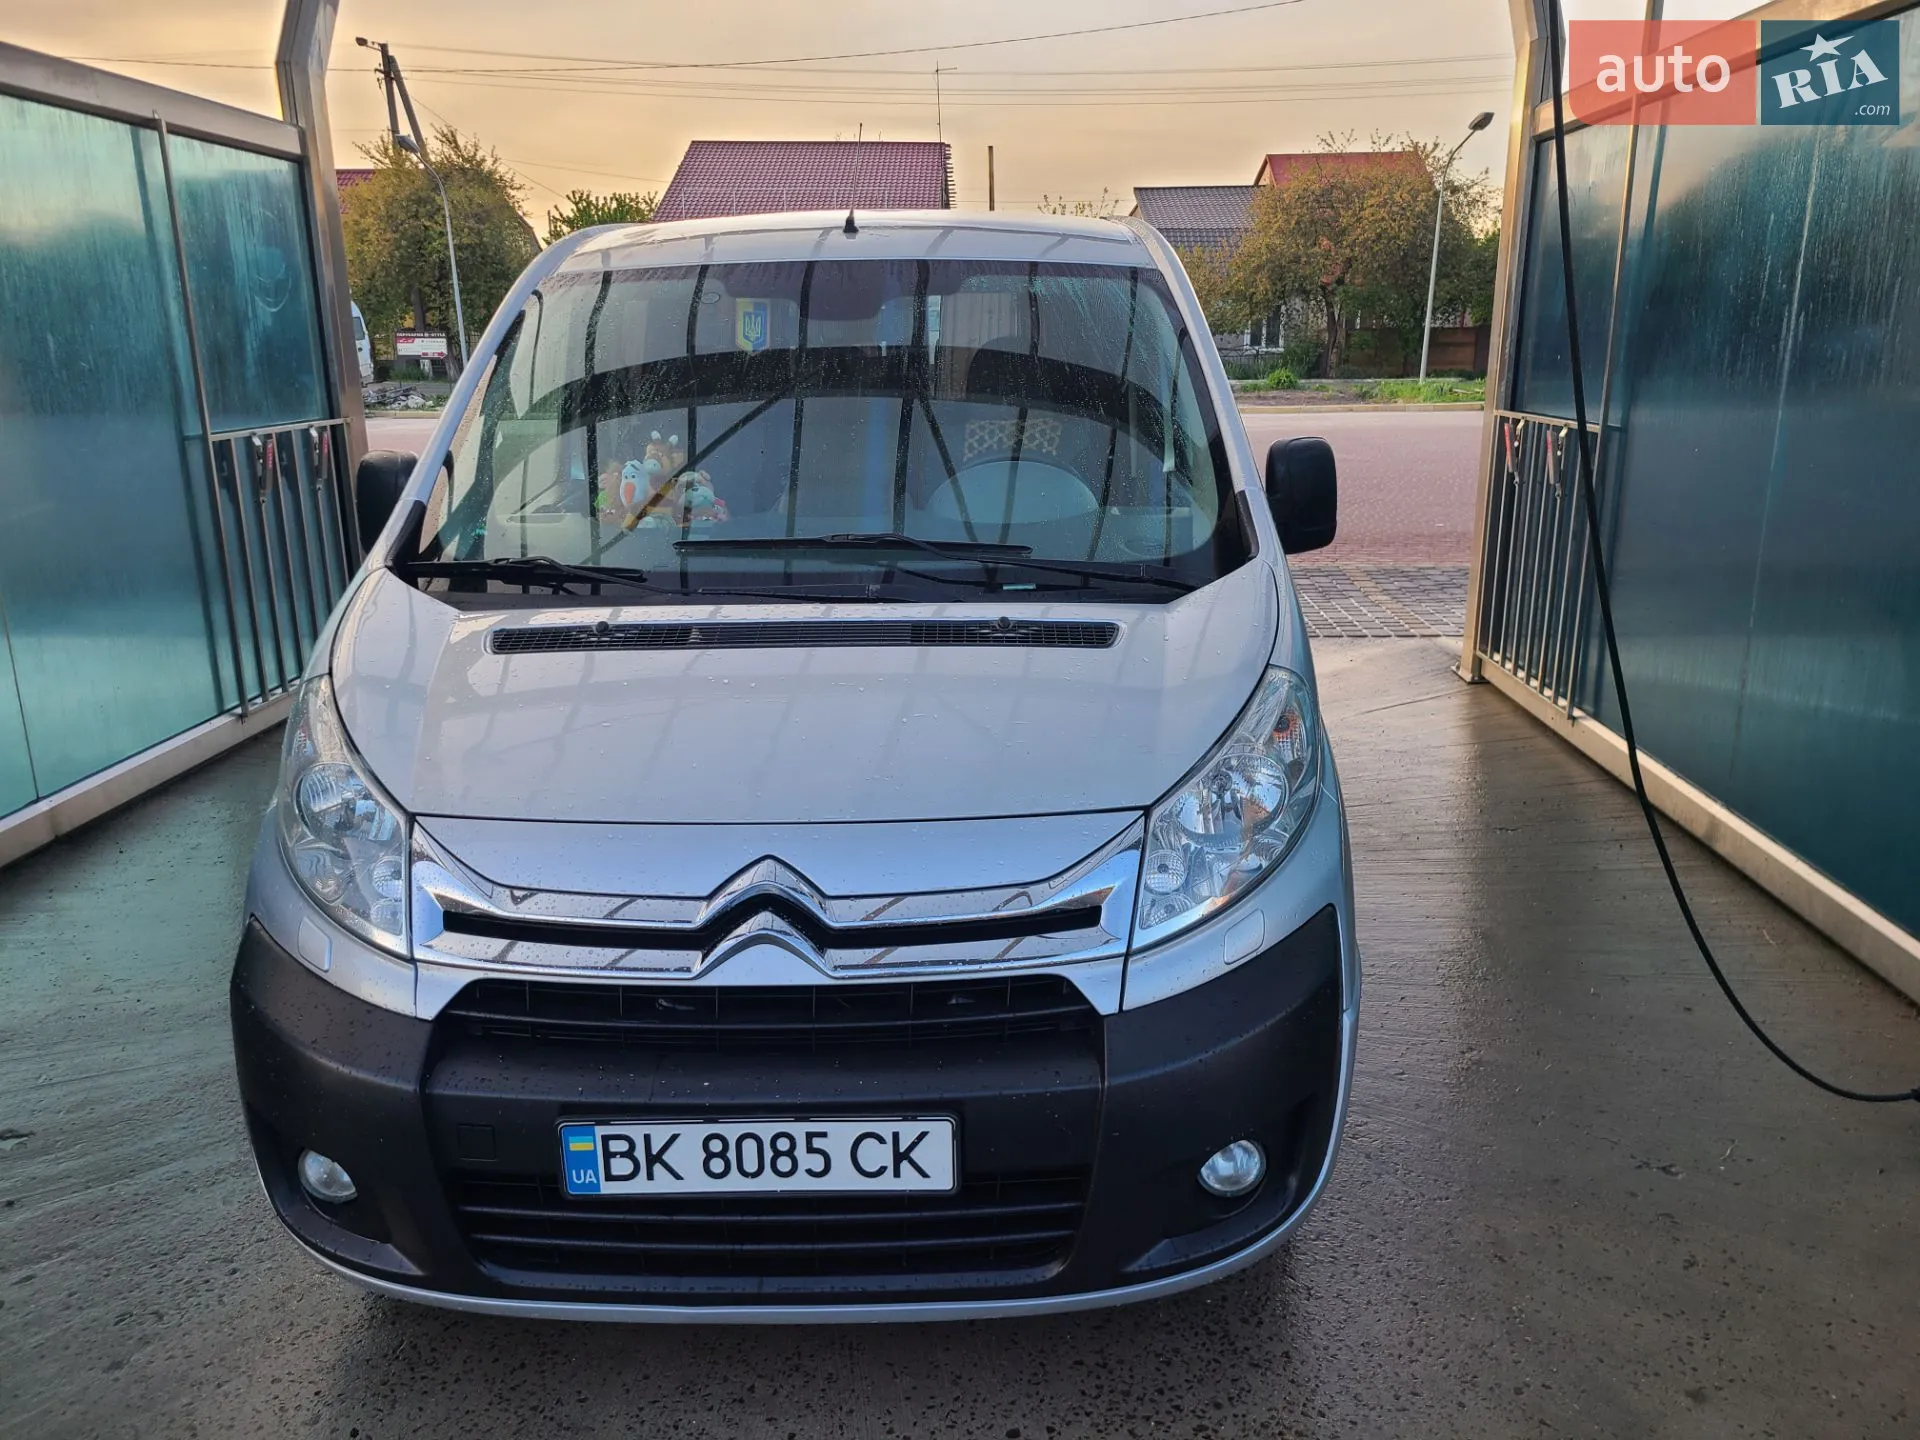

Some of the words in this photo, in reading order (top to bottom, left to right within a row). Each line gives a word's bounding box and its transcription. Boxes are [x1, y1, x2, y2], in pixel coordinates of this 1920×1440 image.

[601, 1132, 684, 1182] BK
[702, 1131, 832, 1180] 8085
[850, 1131, 931, 1179] CK
[571, 1169, 597, 1184] UA
